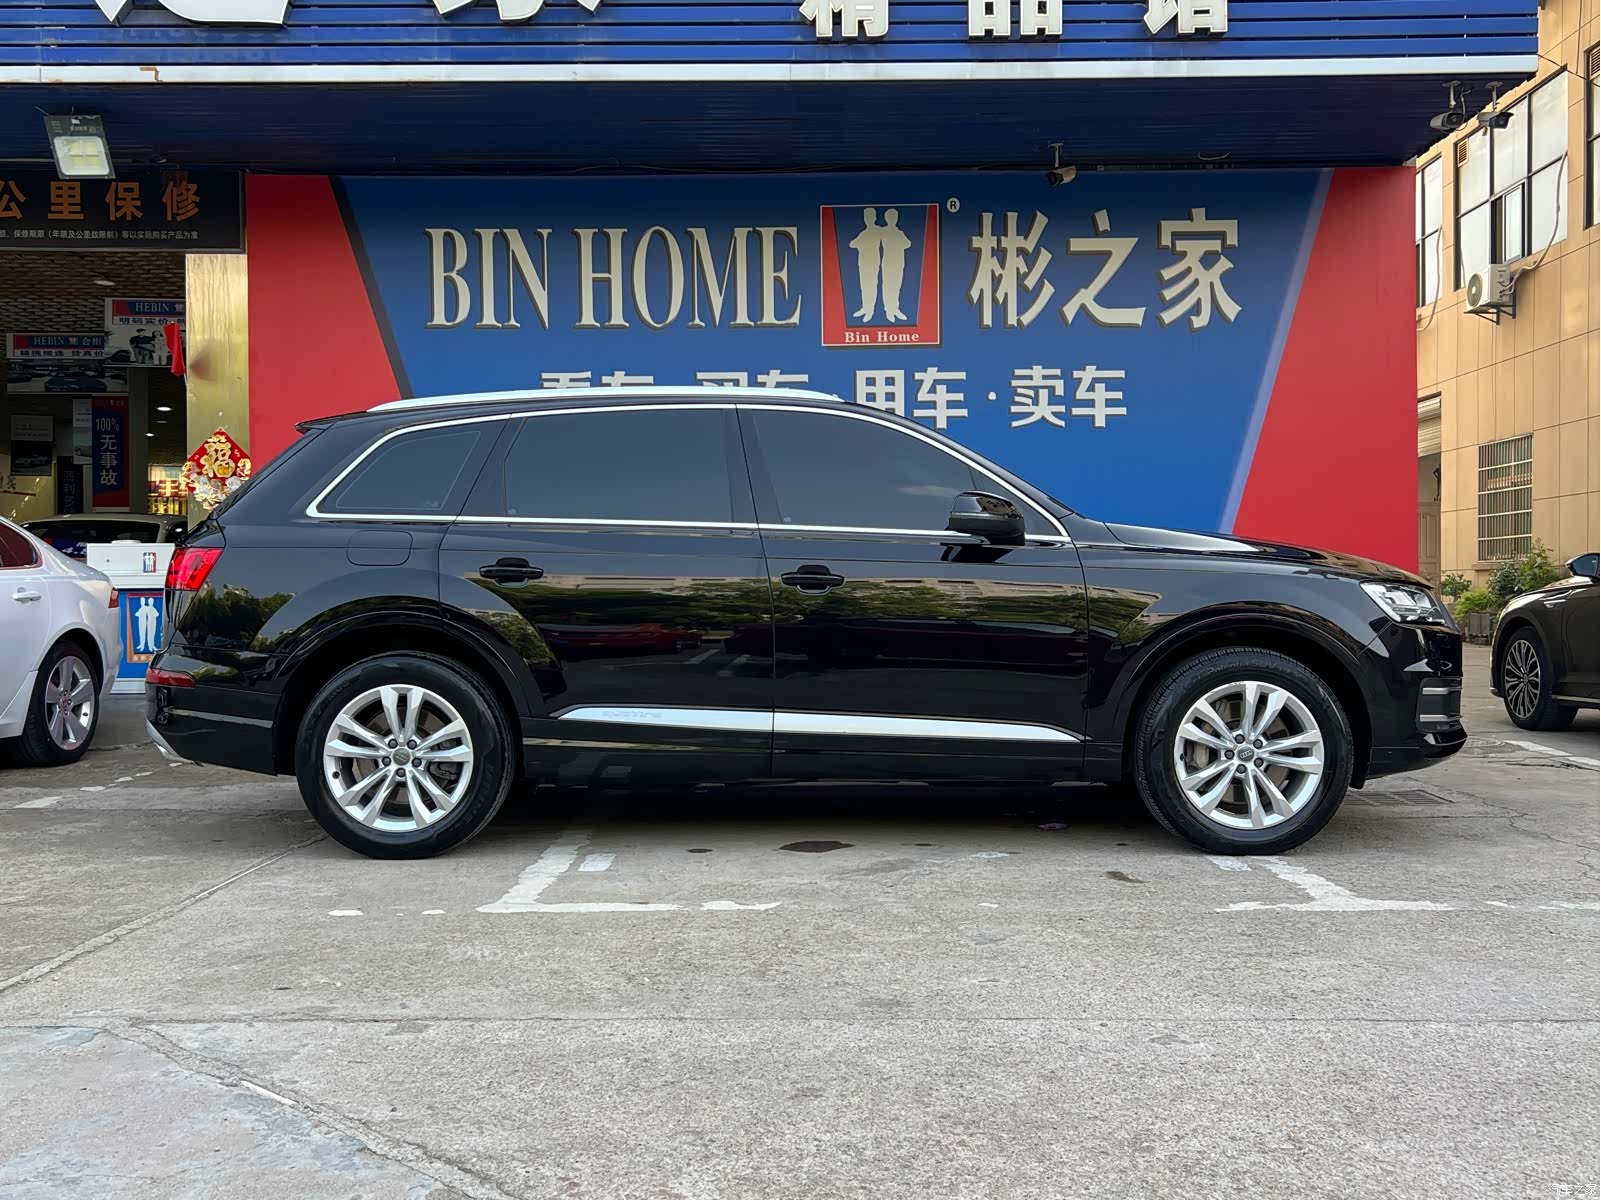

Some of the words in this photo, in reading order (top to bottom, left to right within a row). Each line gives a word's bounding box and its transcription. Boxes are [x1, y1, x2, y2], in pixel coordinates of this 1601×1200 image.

[969, 207, 1242, 330] 彬之家
[425, 228, 552, 330] BIN
[575, 226, 802, 330] HOME
[135, 302, 170, 313] HEBIN
[33, 336, 65, 345] HEBIN
[844, 330, 871, 344] Bin
[877, 330, 920, 344] Home
[95, 416, 120, 432] 100%
[99, 434, 118, 486] 无事故
